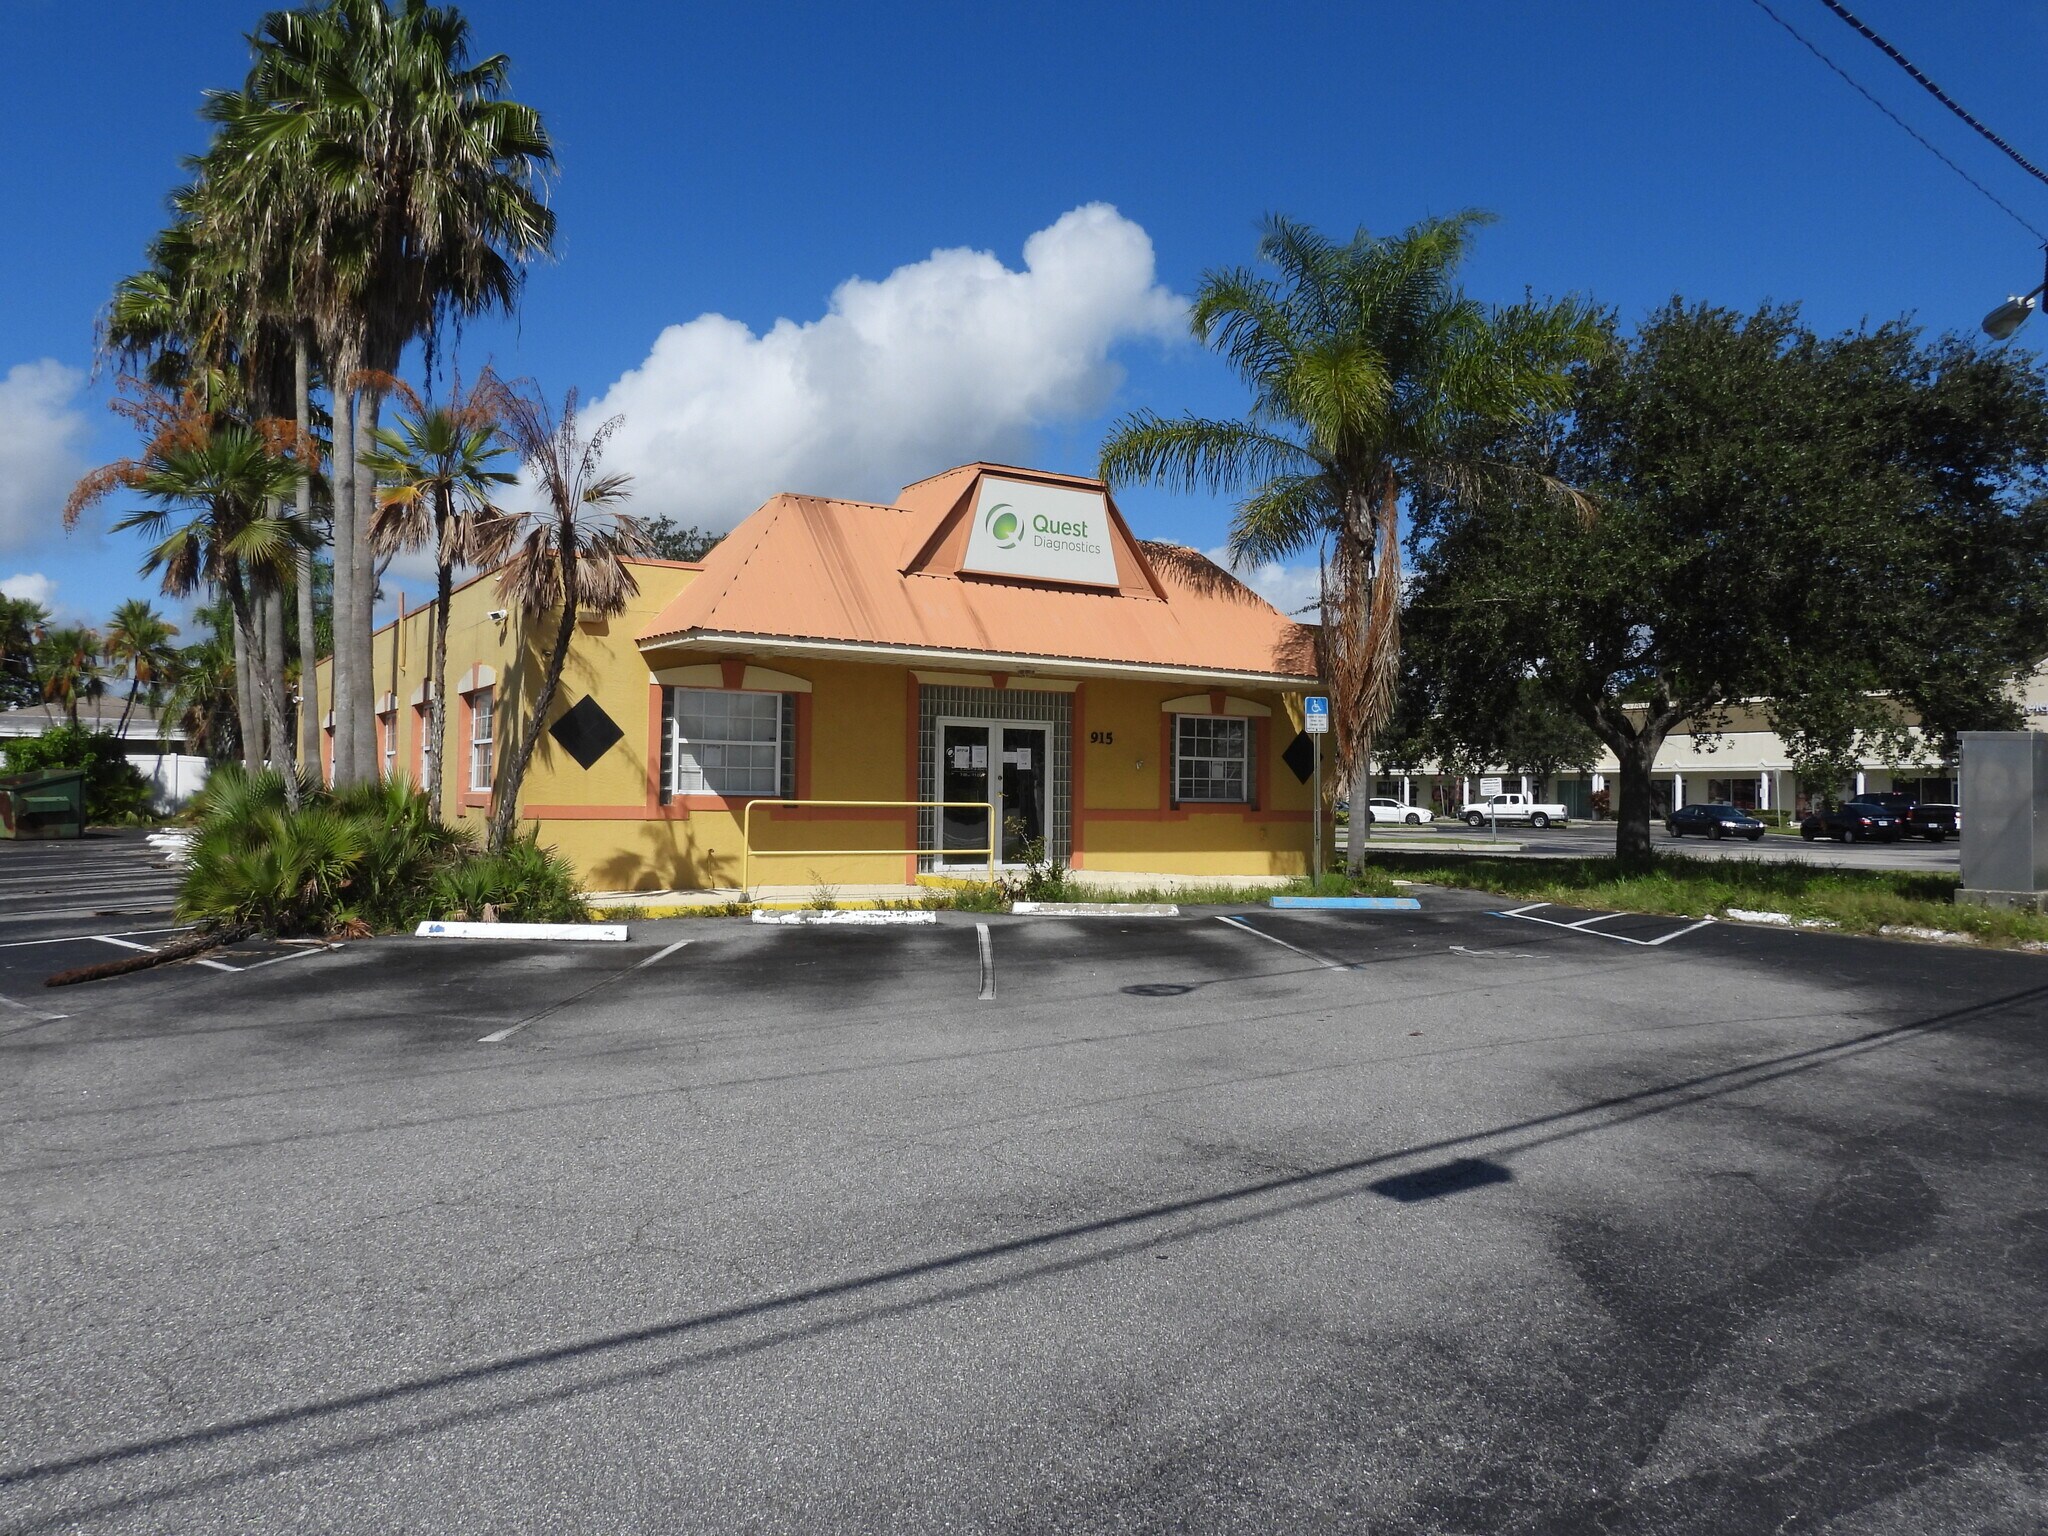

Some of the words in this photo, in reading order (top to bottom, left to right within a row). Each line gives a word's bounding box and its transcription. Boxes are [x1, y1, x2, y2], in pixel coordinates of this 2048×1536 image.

[1033, 514, 1088, 538] Quest
[1034, 535, 1101, 554] Diagnostics
[1090, 731, 1114, 745] 915
